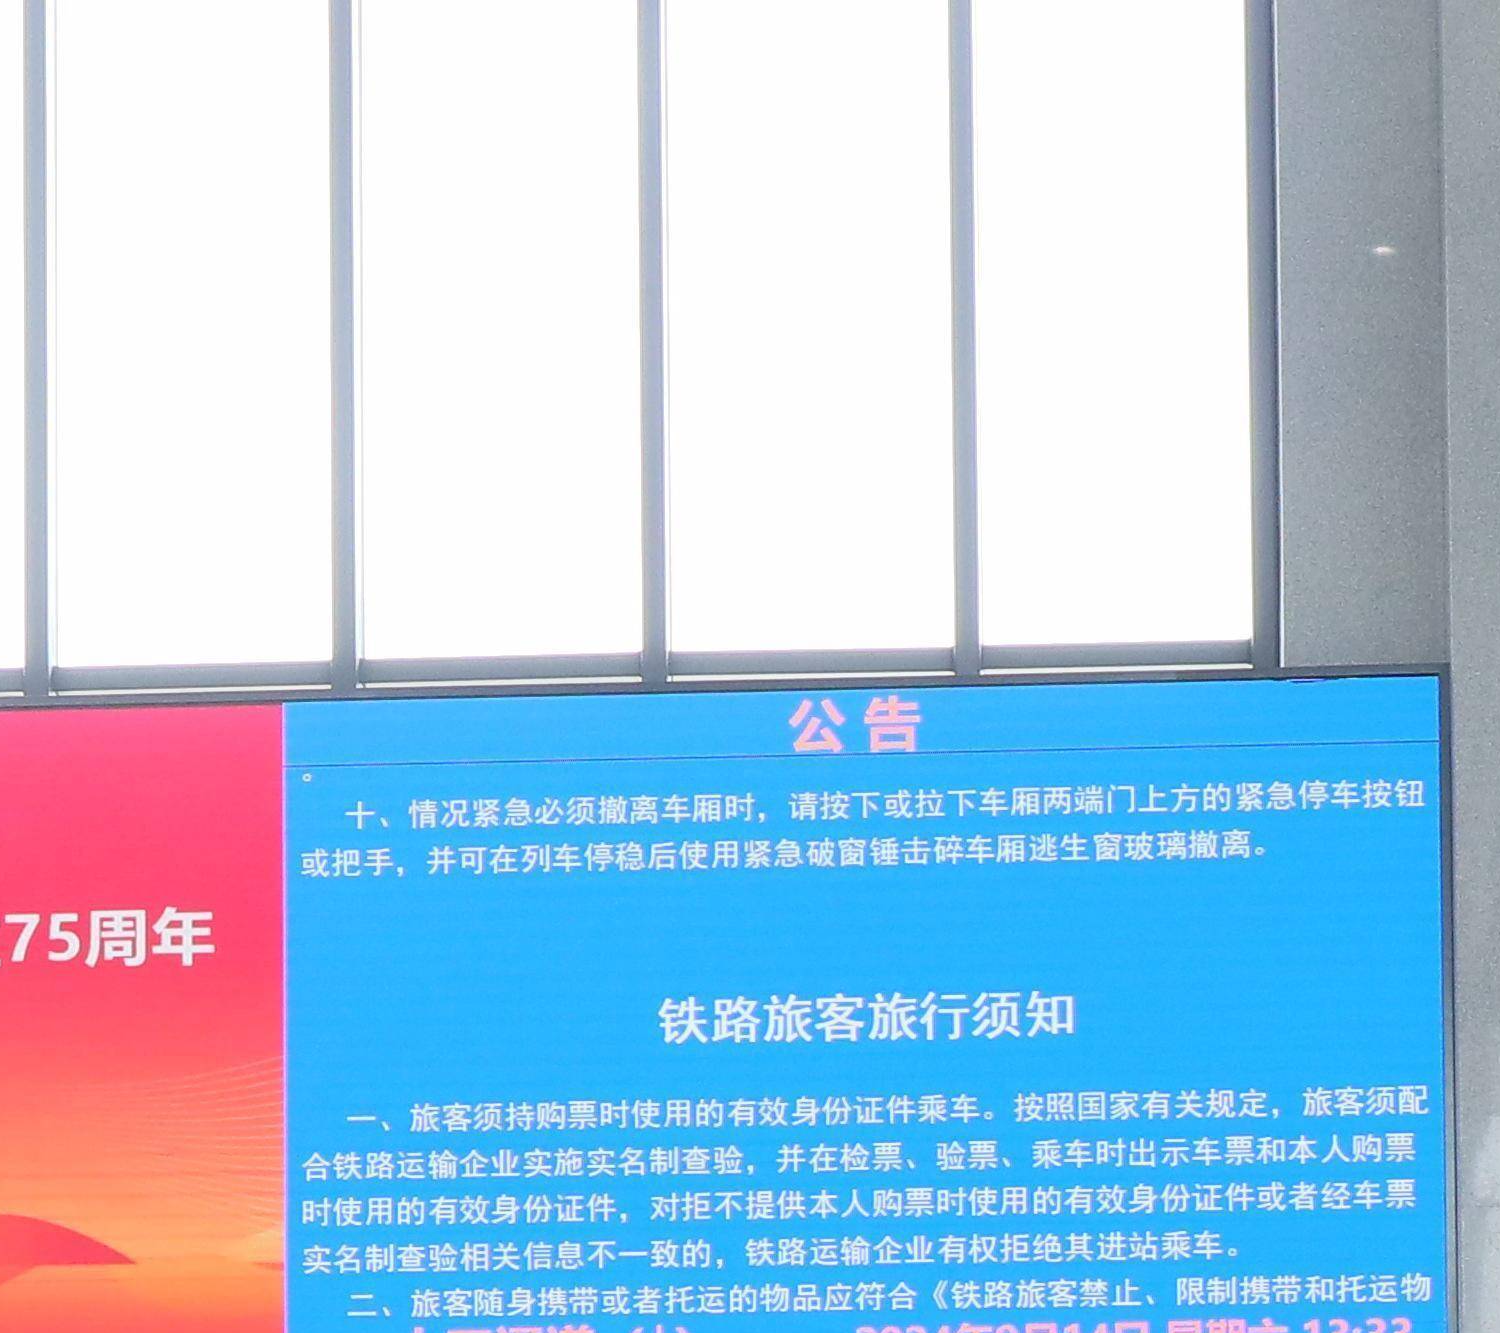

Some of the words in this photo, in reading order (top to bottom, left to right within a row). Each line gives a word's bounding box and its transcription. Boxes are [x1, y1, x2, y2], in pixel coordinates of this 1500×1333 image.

[789, 696, 921, 753] 公告
[659, 994, 1076, 1044] 铁路旅客旅行须知
